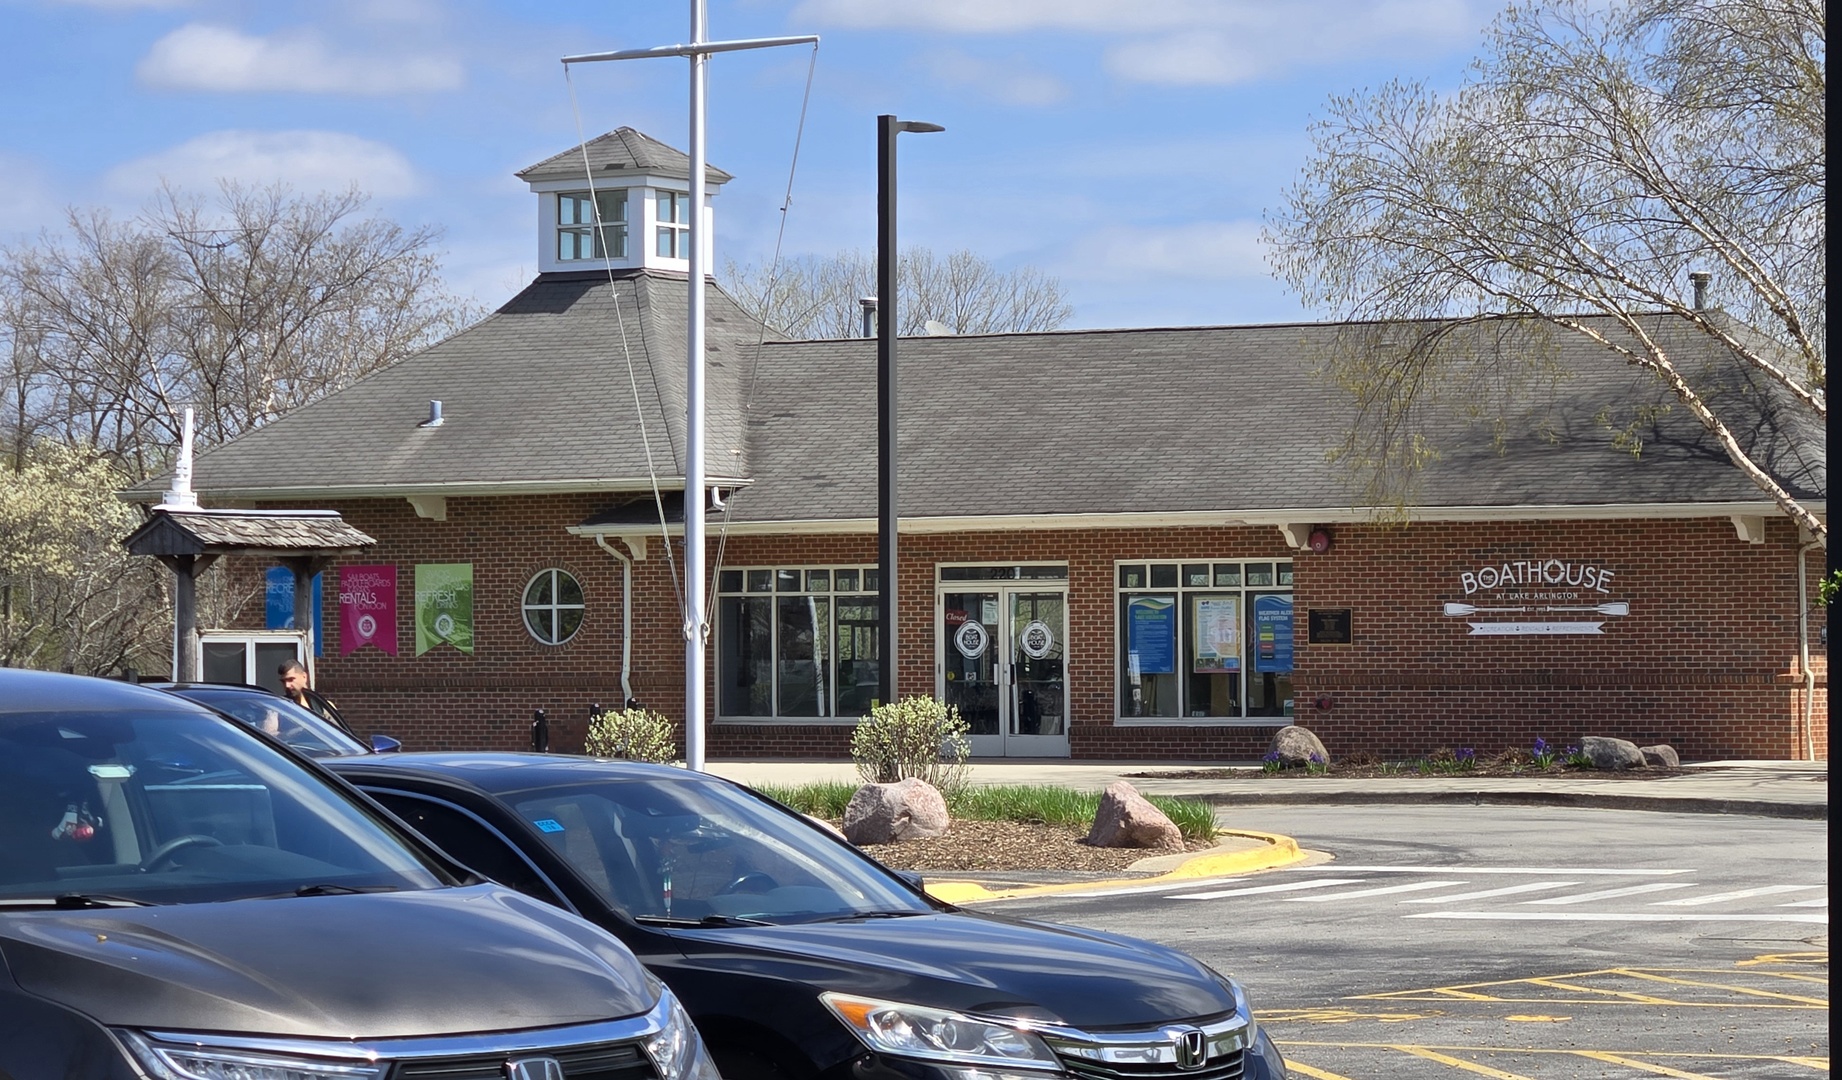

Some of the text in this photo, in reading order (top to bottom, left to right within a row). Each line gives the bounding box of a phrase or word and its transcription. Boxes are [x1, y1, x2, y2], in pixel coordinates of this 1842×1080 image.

[991, 568, 1015, 579] 220
[1461, 559, 1615, 595] BOATHOUSE
[341, 579, 391, 587] PADDLEBOARDS
[339, 592, 377, 604] RENTALS
[415, 591, 456, 603] REFRESH
[1534, 592, 1578, 600] ARLINGTON
[354, 602, 387, 610] PONTOON
[946, 613, 967, 621] Closed
